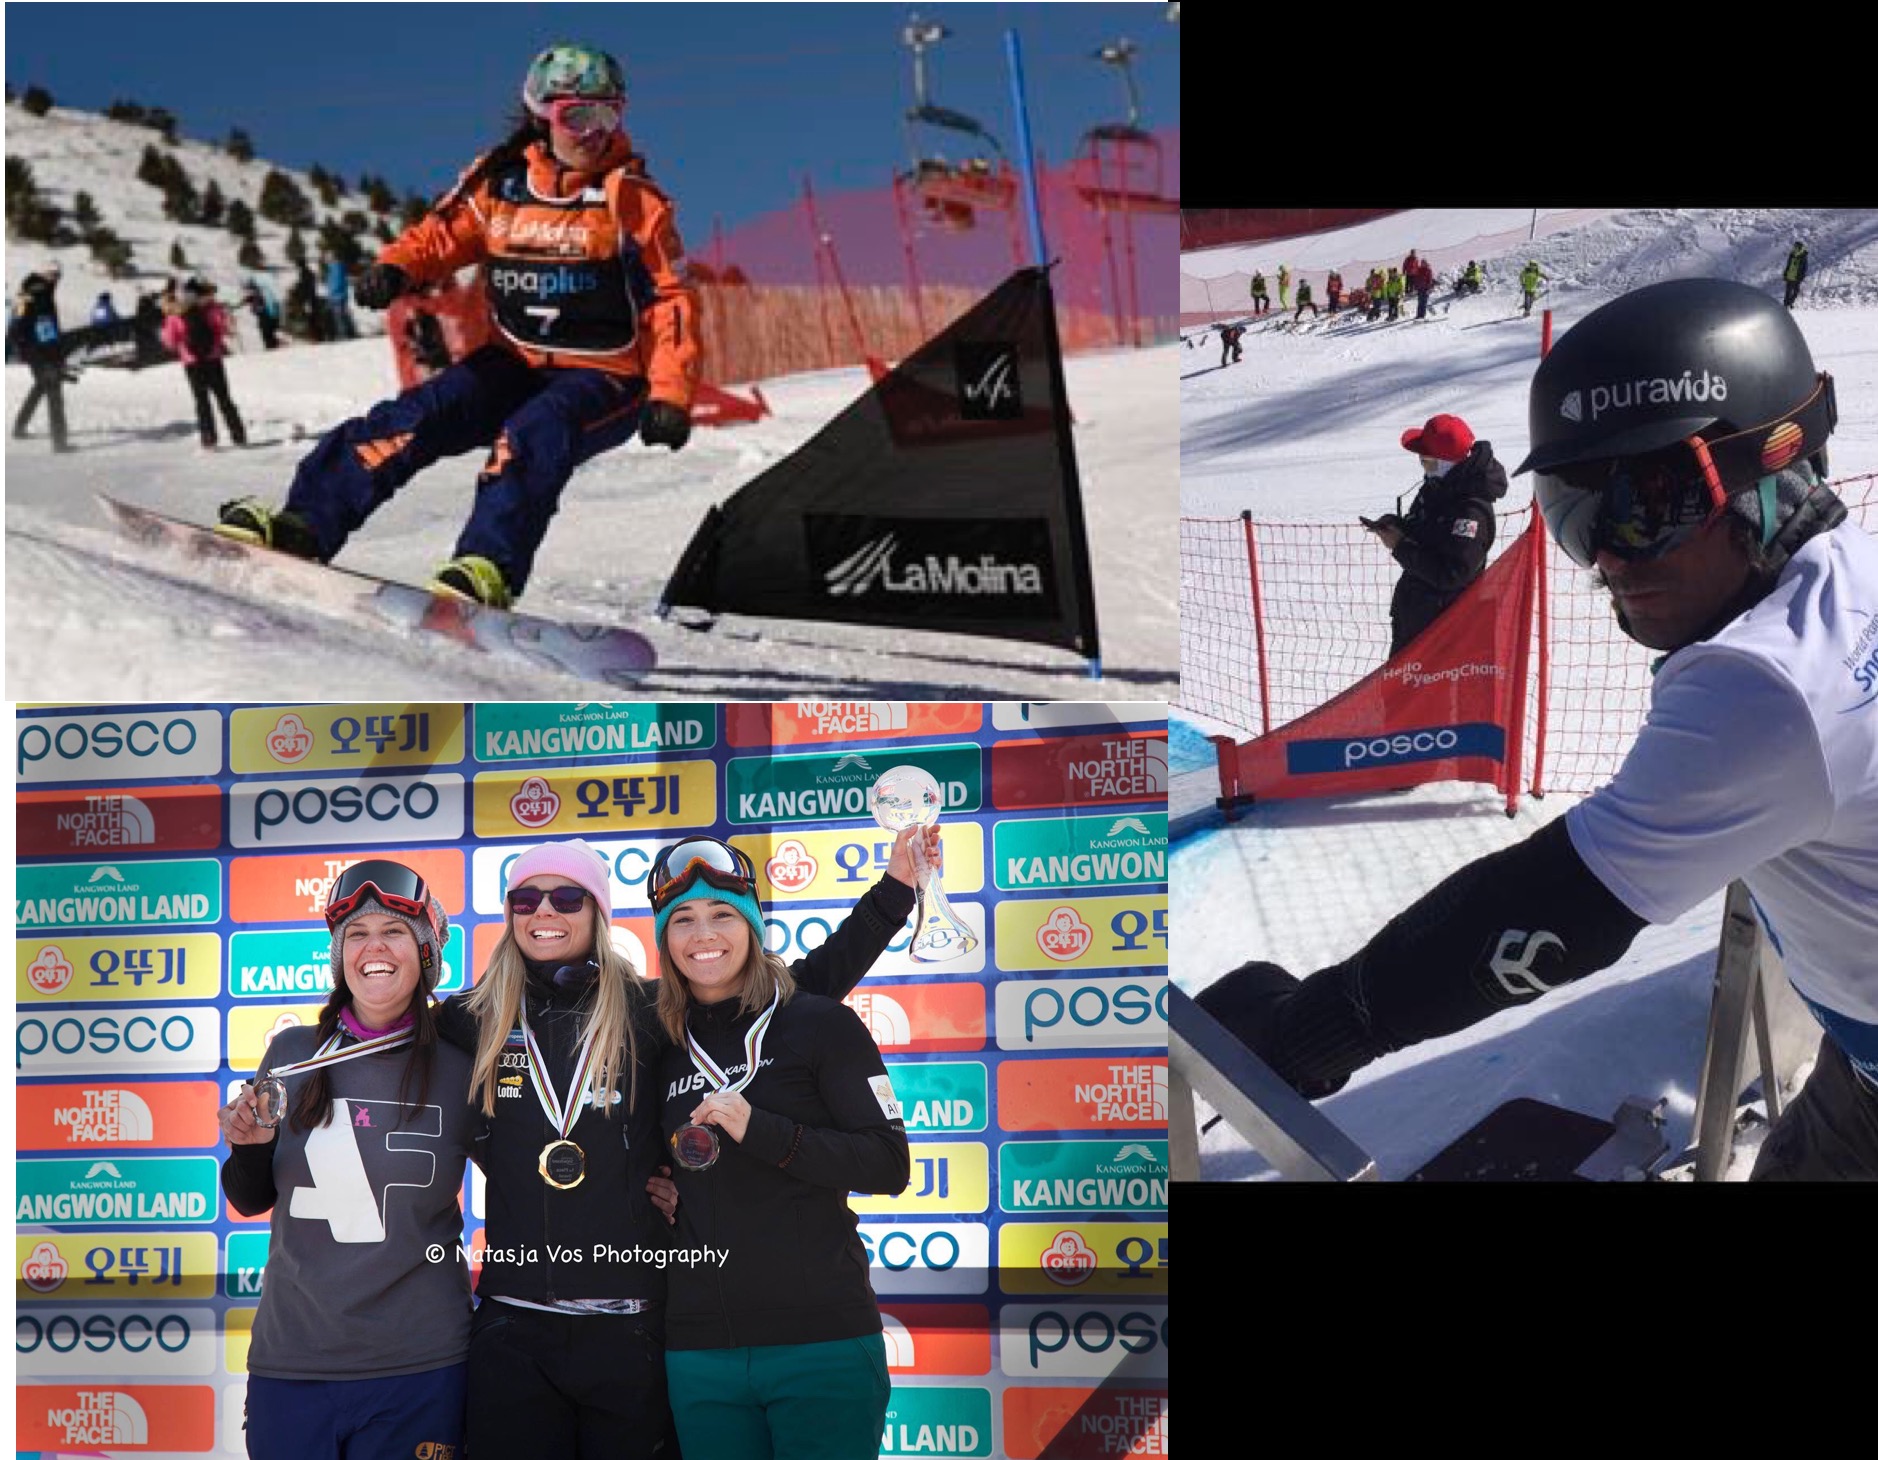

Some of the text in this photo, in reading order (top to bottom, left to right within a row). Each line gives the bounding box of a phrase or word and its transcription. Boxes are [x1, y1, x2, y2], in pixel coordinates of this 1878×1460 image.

[523, 305, 560, 335] 7
[1591, 370, 1728, 420] puravida
[1384, 661, 1422, 680] Hello
[559, 711, 629, 722] KANGWON LAND
[818, 714, 868, 734] FACE
[330, 713, 429, 754] 오뚜기
[486, 720, 704, 756] KANGWON LAND
[18, 719, 196, 775] posco
[1102, 739, 1145, 759] THE
[1345, 730, 1458, 768] posco
[816, 774, 862, 784] KANGWON
[1069, 758, 1145, 780] NORTH
[1091, 776, 1145, 796] FACE
[85, 795, 121, 812] THE
[576, 775, 680, 818] 오뚜기
[255, 781, 439, 841] posco
[519, 801, 551, 816] 오뚜기
[57, 812, 121, 830] NORTH
[75, 829, 121, 846] FACE
[1090, 836, 1168, 849] KANGWON LAND
[774, 864, 810, 881] 오뚜기
[1008, 851, 1165, 885] KANGWON
[117, 884, 139, 892] LAND
[141, 894, 209, 921] LAND
[1047, 933, 1083, 949] 오뚜기
[90, 948, 186, 986] 오뚜기
[241, 964, 335, 992] KANGW
[16, 1015, 194, 1069] posco
[724, 1058, 774, 1076] KARON
[1108, 1065, 1151, 1084] THE
[83, 1090, 118, 1107] THE
[1075, 1083, 1151, 1103] NORTH
[54, 1107, 119, 1126] NORTH
[1097, 1102, 1152, 1121] FACE
[72, 1124, 119, 1142] FACE
[1096, 1164, 1146, 1173] KANGWON
[70, 1180, 137, 1189] KANGWON LAND
[1013, 1178, 1168, 1207] KANGWON
[16, 1192, 207, 1220] ANGWON LAND
[84, 1247, 182, 1286] 오뚜기
[1029, 1311, 1168, 1369] pos
[77, 1392, 113, 1410] THE
[1115, 1397, 1159, 1416] THE
[48, 1409, 113, 1427] NORTH
[1081, 1415, 1160, 1436] NORTH
[66, 1426, 113, 1445] FACE
[900, 1424, 979, 1453] LAND
[1104, 1435, 1161, 1455] FACE
